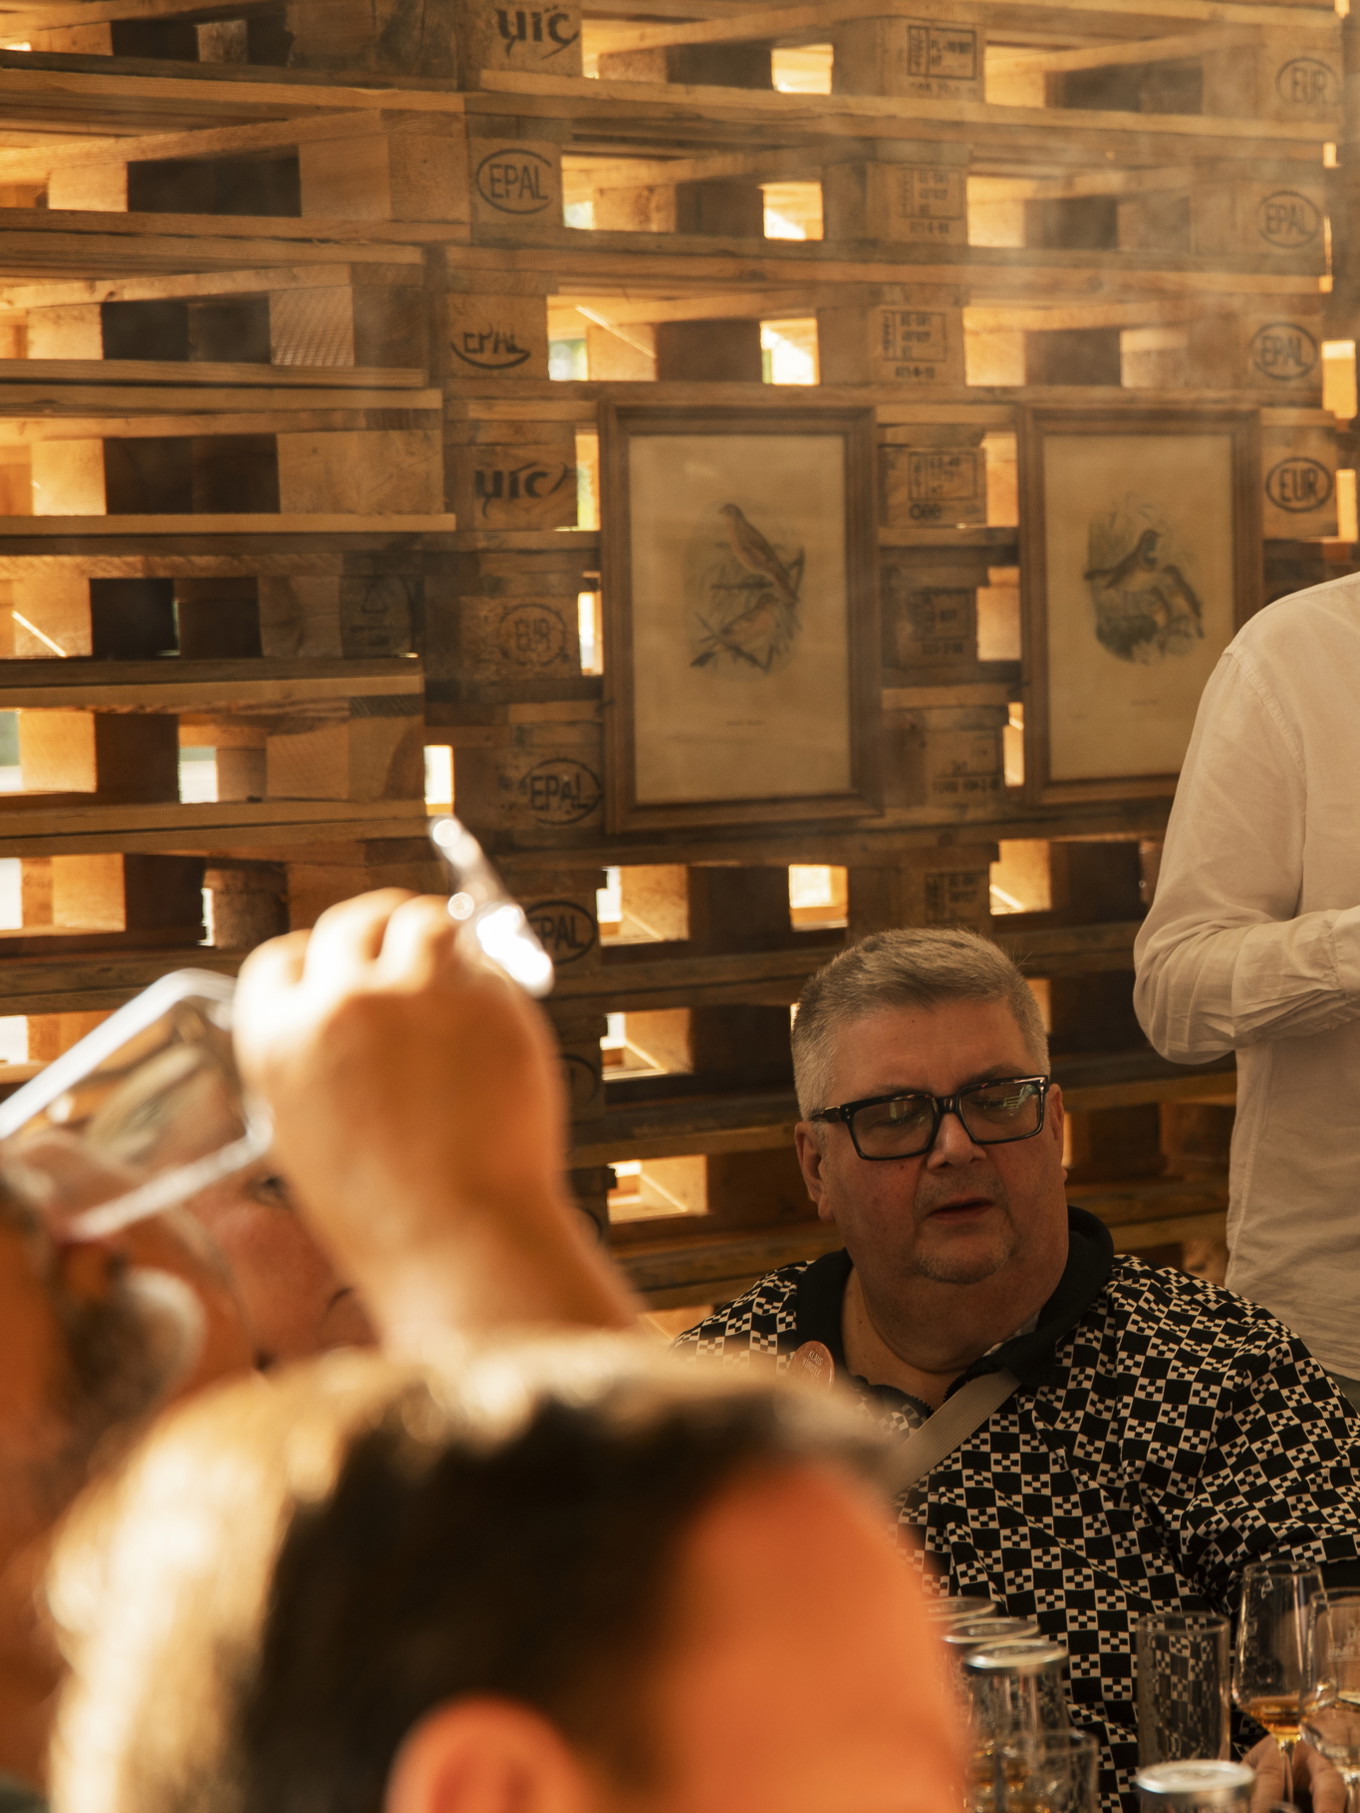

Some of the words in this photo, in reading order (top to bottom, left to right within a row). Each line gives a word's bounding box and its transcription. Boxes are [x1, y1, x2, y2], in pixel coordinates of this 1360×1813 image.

[489, 163, 549, 201] EPAL
[1278, 467, 1318, 503] EUR
[529, 775, 590, 812] EPAL
